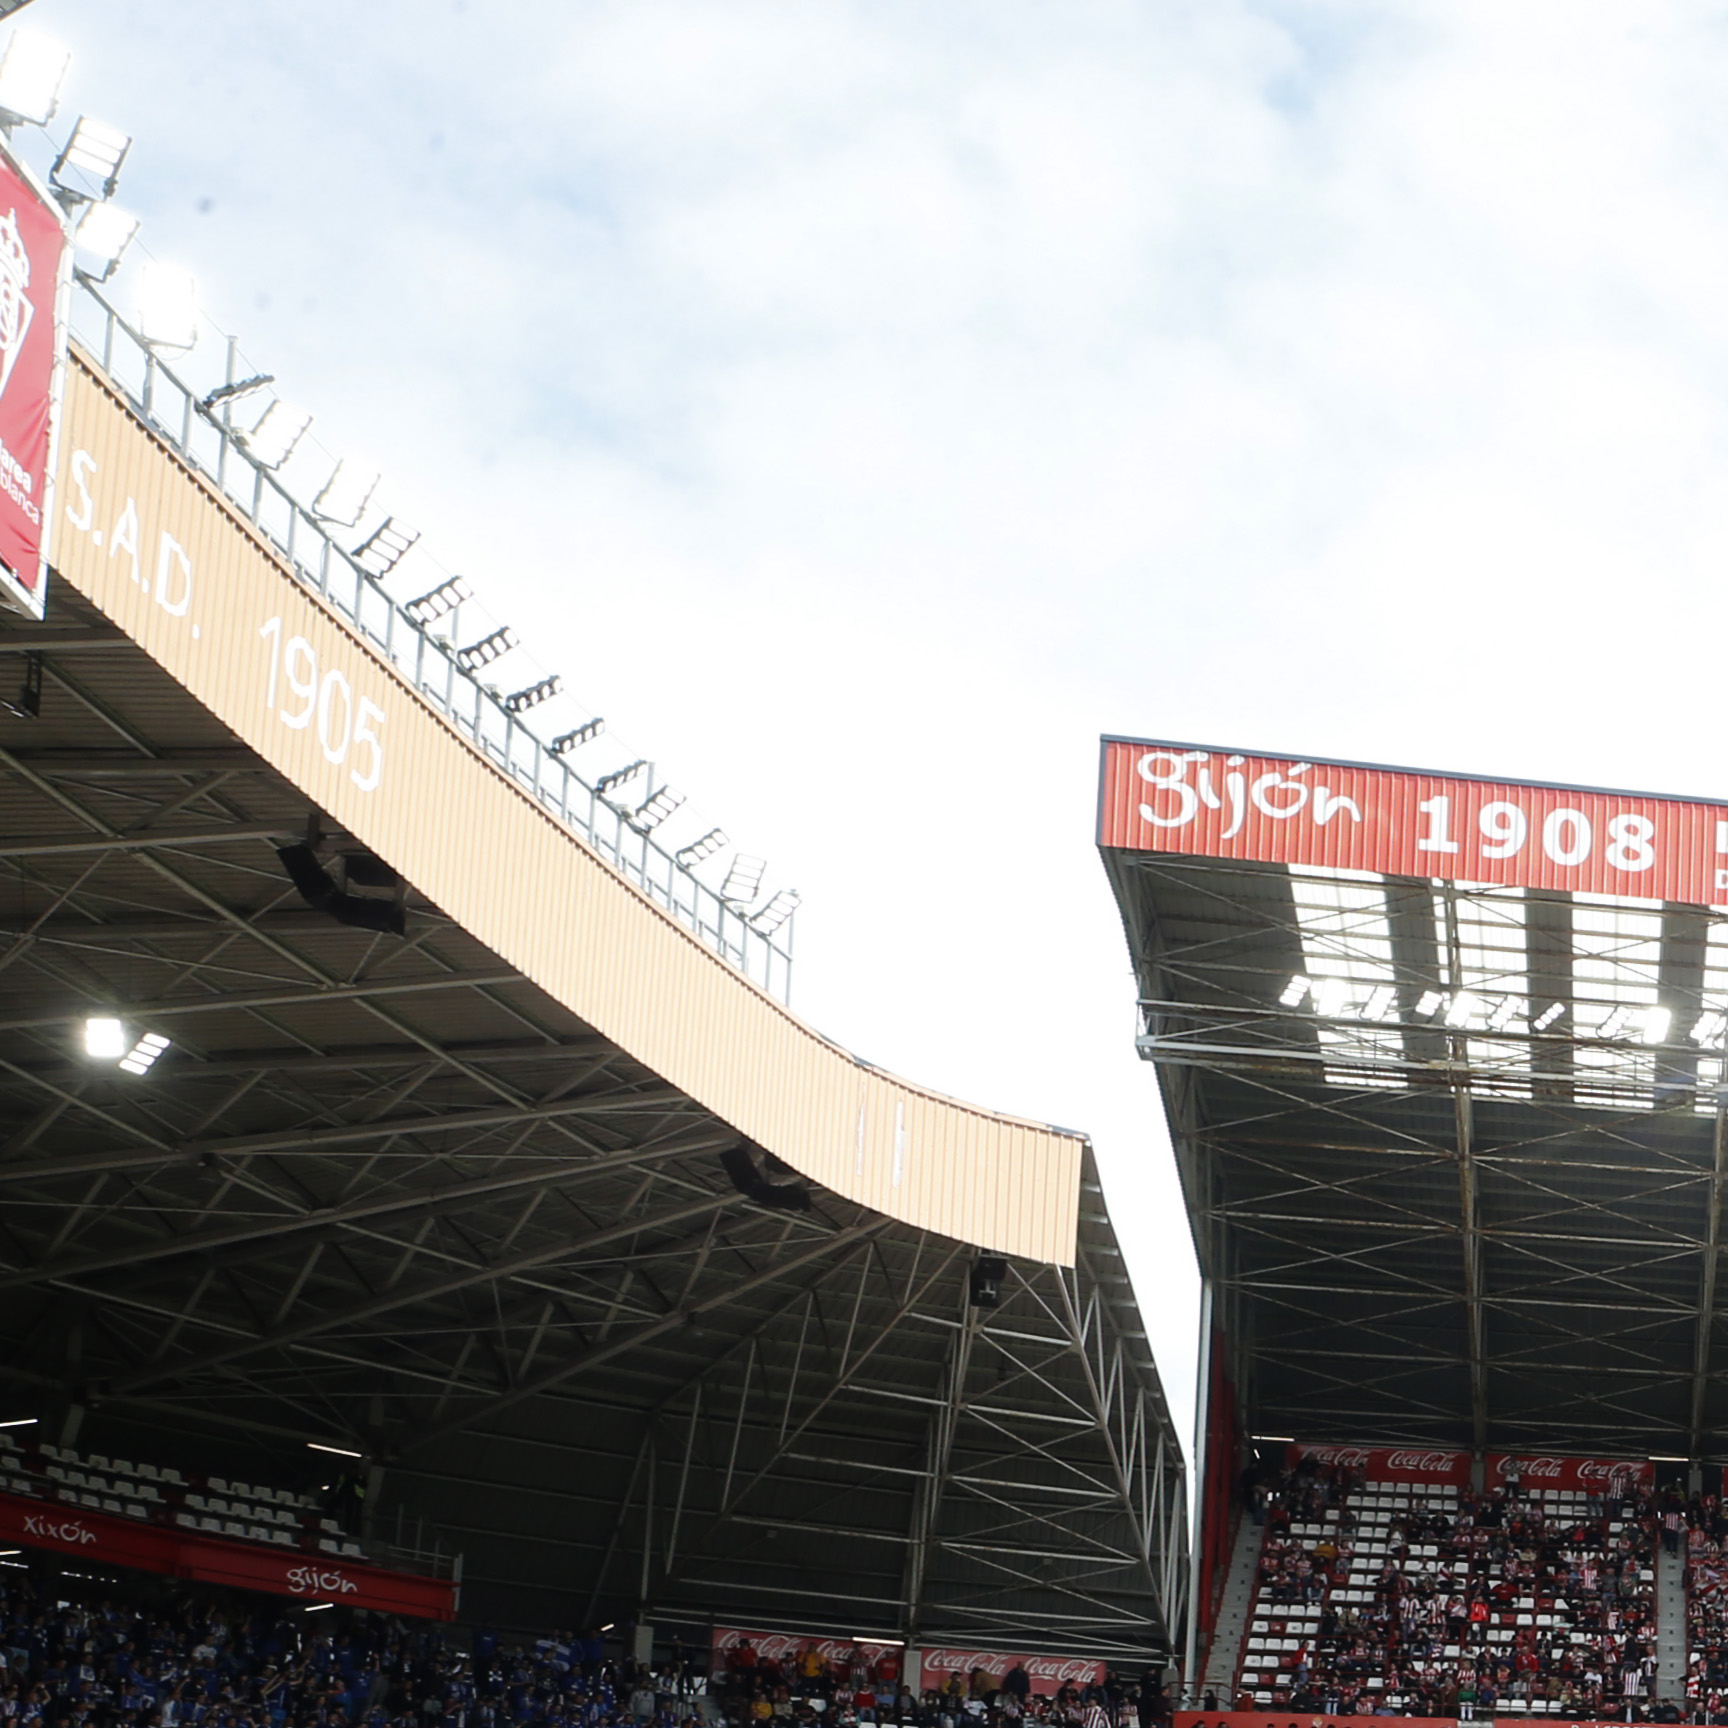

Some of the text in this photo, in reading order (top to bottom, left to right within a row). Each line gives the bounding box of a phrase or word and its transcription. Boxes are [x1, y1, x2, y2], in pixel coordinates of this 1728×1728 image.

[66, 449, 386, 792] S.A.D. 1905
[1417, 795, 1656, 871] 1908
[1387, 1450, 1457, 1472] Coca-Cola
[925, 1650, 1007, 1675] Coca-Cola
[1024, 1657, 1096, 1683] Coca-Cola
